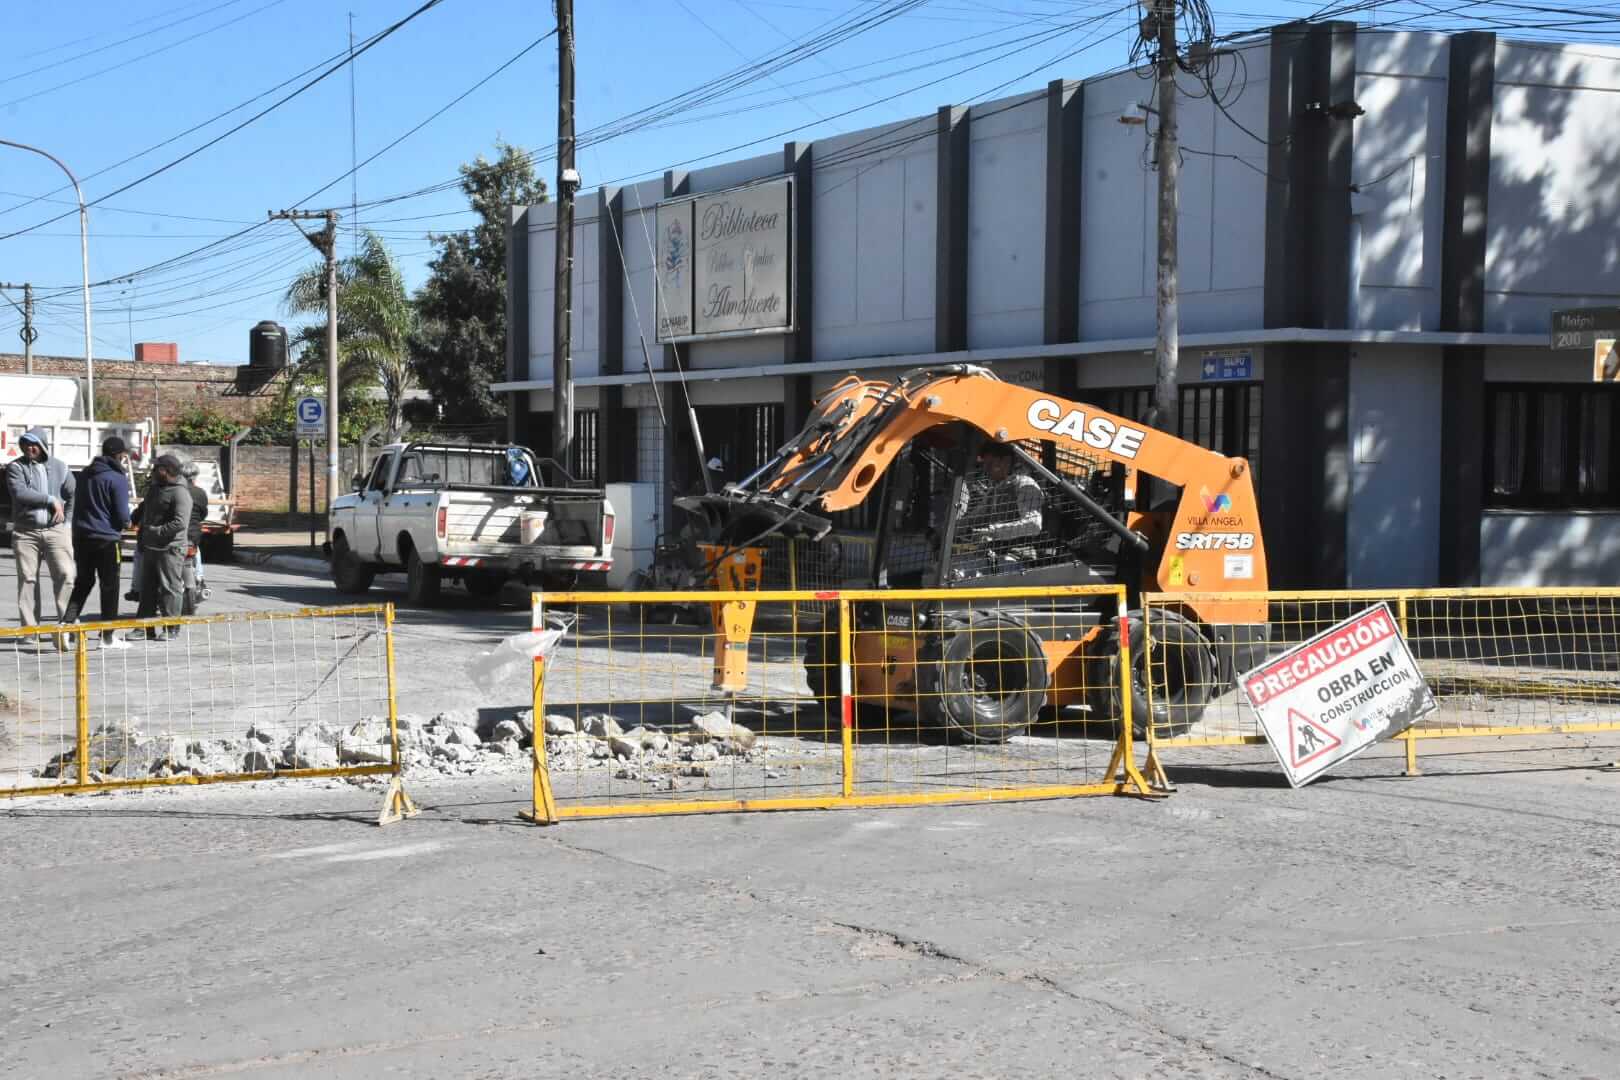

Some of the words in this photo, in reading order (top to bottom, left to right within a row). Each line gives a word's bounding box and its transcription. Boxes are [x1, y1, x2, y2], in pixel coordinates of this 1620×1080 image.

[701, 202, 779, 240] Biblioteca
[703, 283, 780, 321] Almafuerte
[1558, 331, 1581, 346] 200
[303, 402, 318, 419] E
[1027, 398, 1146, 459] CASE
[1187, 516, 1209, 526] VILLA
[1176, 531, 1255, 550] SR175B
[887, 615, 911, 627] CASE
[1251, 617, 1391, 698] PRECAUCIÓN
[1317, 667, 1369, 703] OBRA
[1368, 652, 1395, 676] EN
